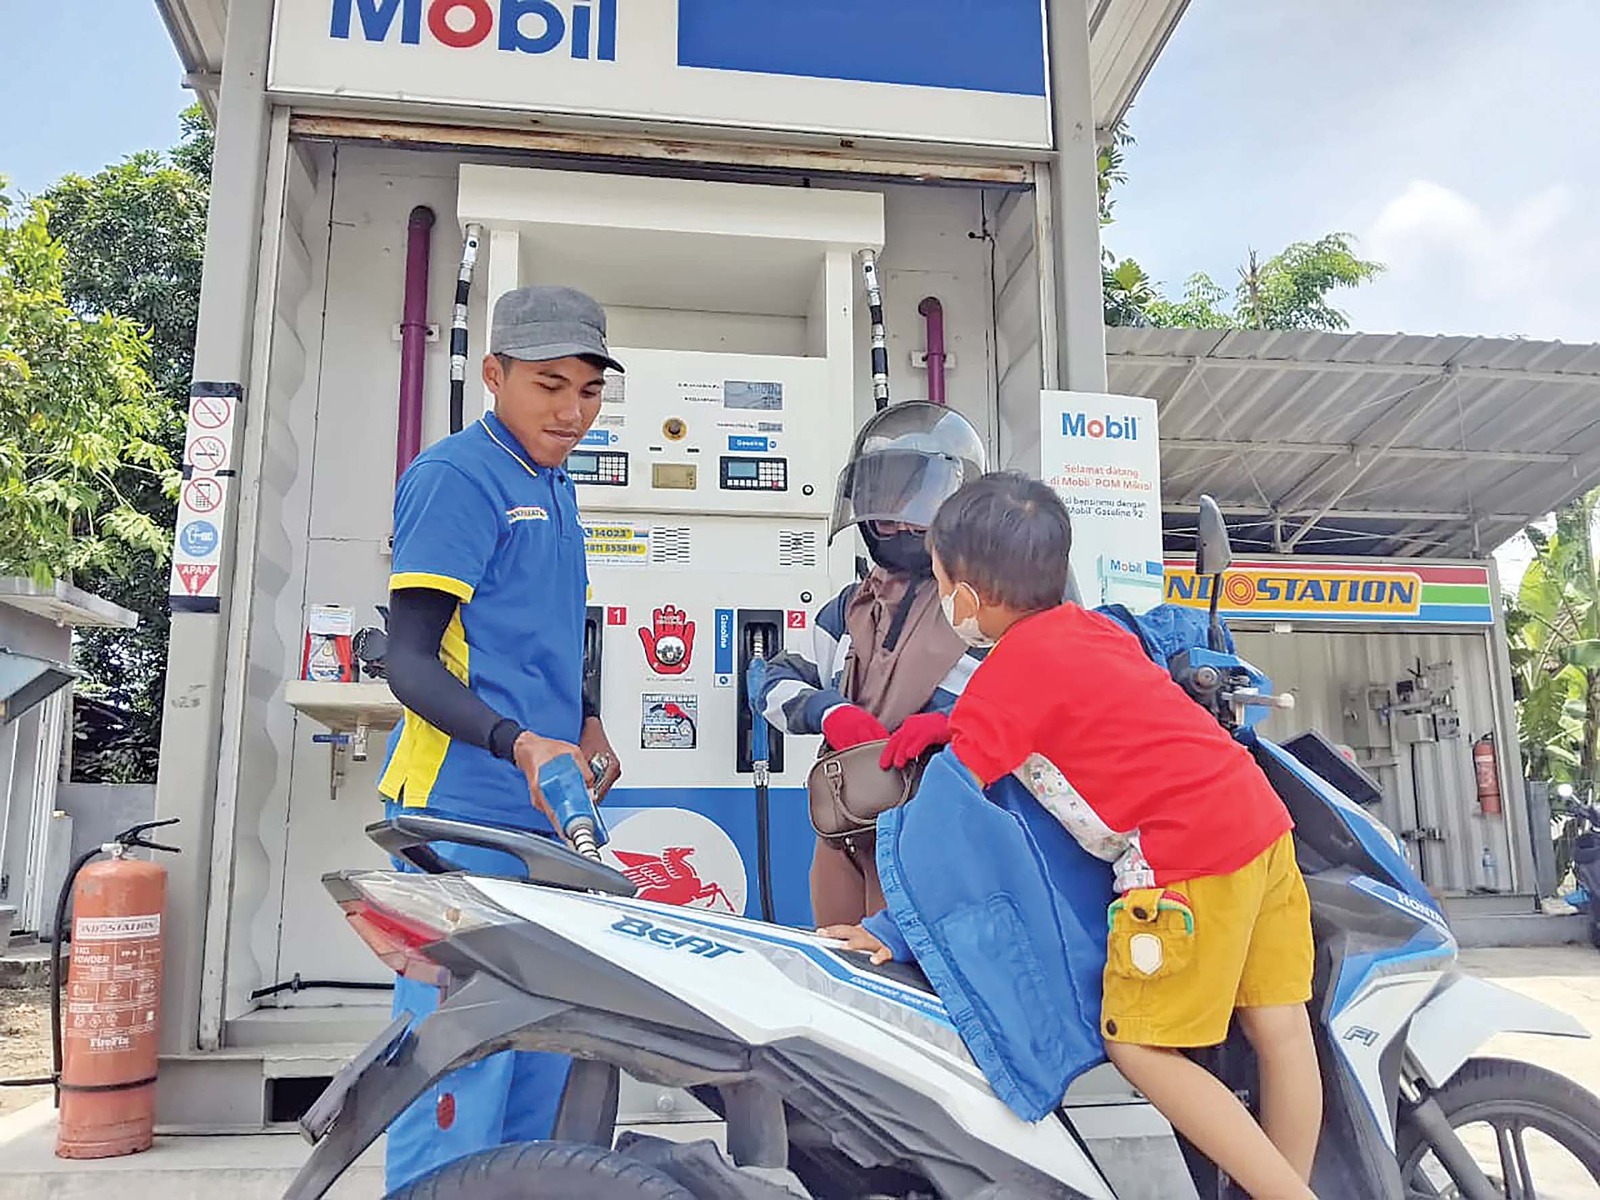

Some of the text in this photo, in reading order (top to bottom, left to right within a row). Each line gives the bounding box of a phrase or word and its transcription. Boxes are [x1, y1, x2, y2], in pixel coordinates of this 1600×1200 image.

[330, 0, 616, 61] Mobil
[1062, 412, 1137, 440] Mobil
[1064, 464, 1138, 479] Selamat datang
[1095, 479, 1120, 488] POM
[181, 565, 211, 575] APAR
[1110, 559, 1142, 573] Mobil
[613, 609, 621, 623] 1
[790, 612, 801, 627] 2
[720, 614, 729, 648] Gasoline
